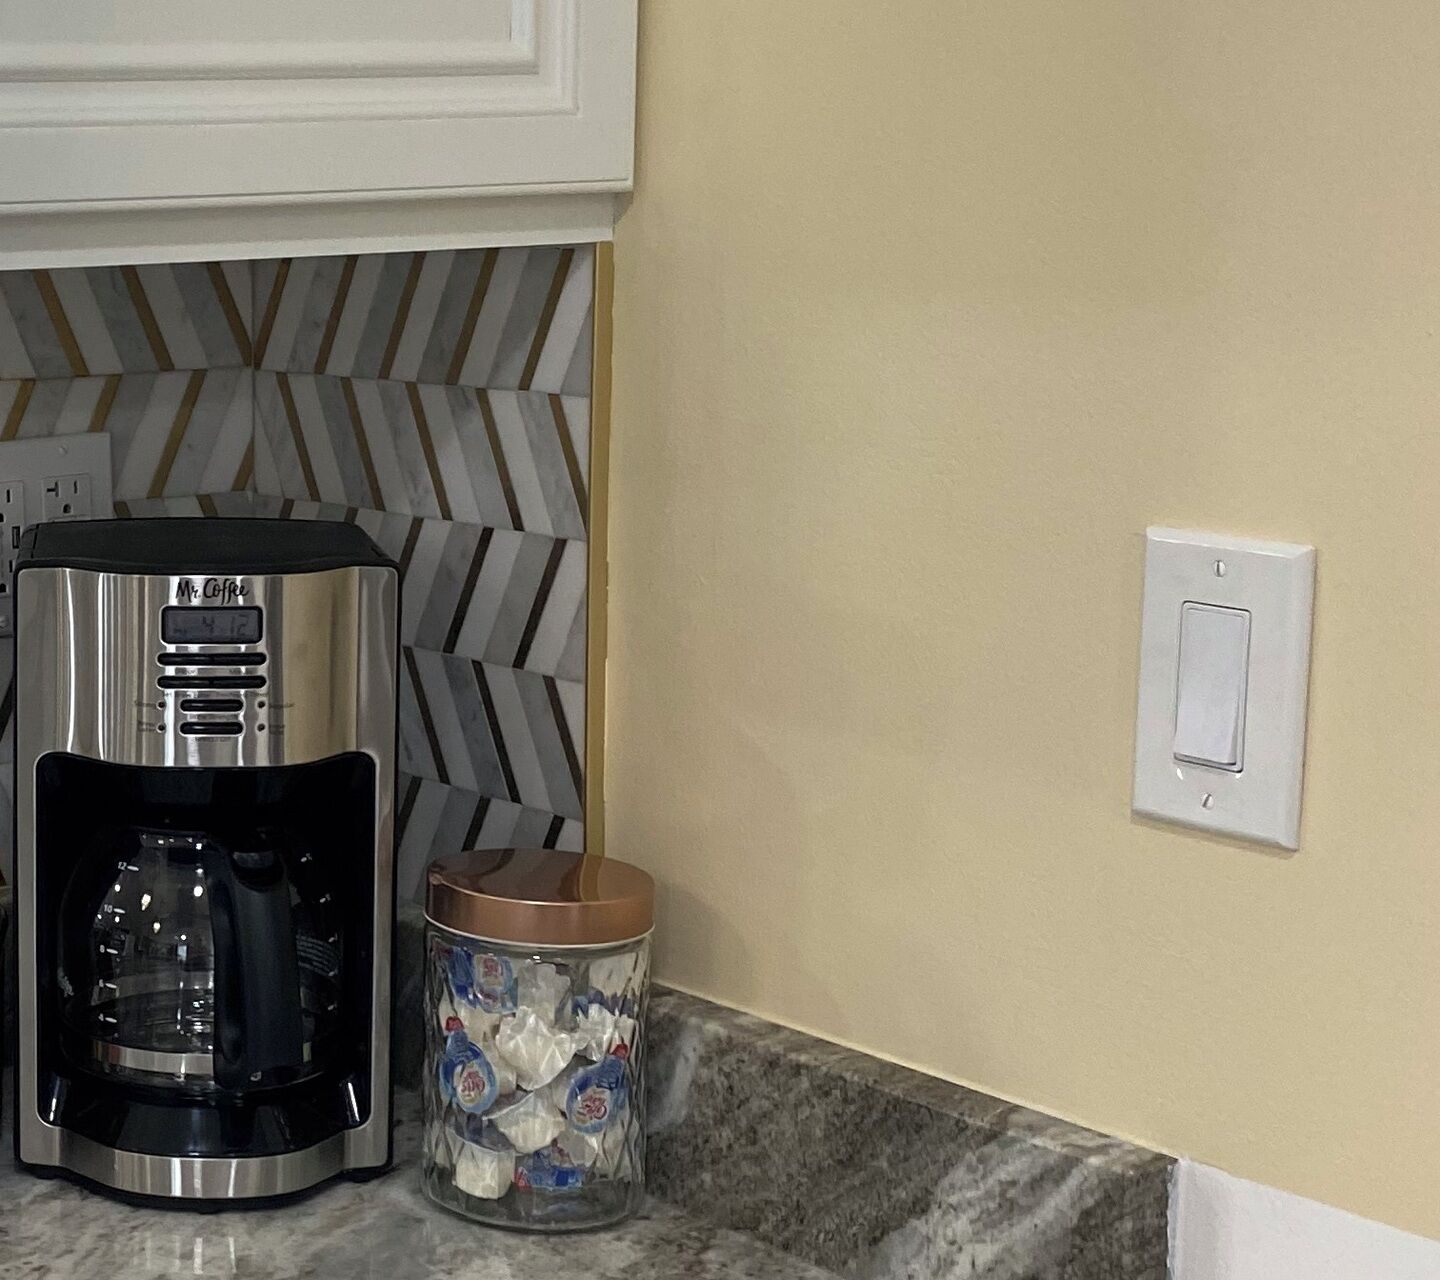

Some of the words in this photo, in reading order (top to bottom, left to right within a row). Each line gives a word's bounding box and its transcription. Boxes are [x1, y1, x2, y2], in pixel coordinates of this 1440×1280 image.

[176, 579, 201, 603] Mr.
[203, 577, 250, 606] Coffee
[104, 904, 113, 913] 10
